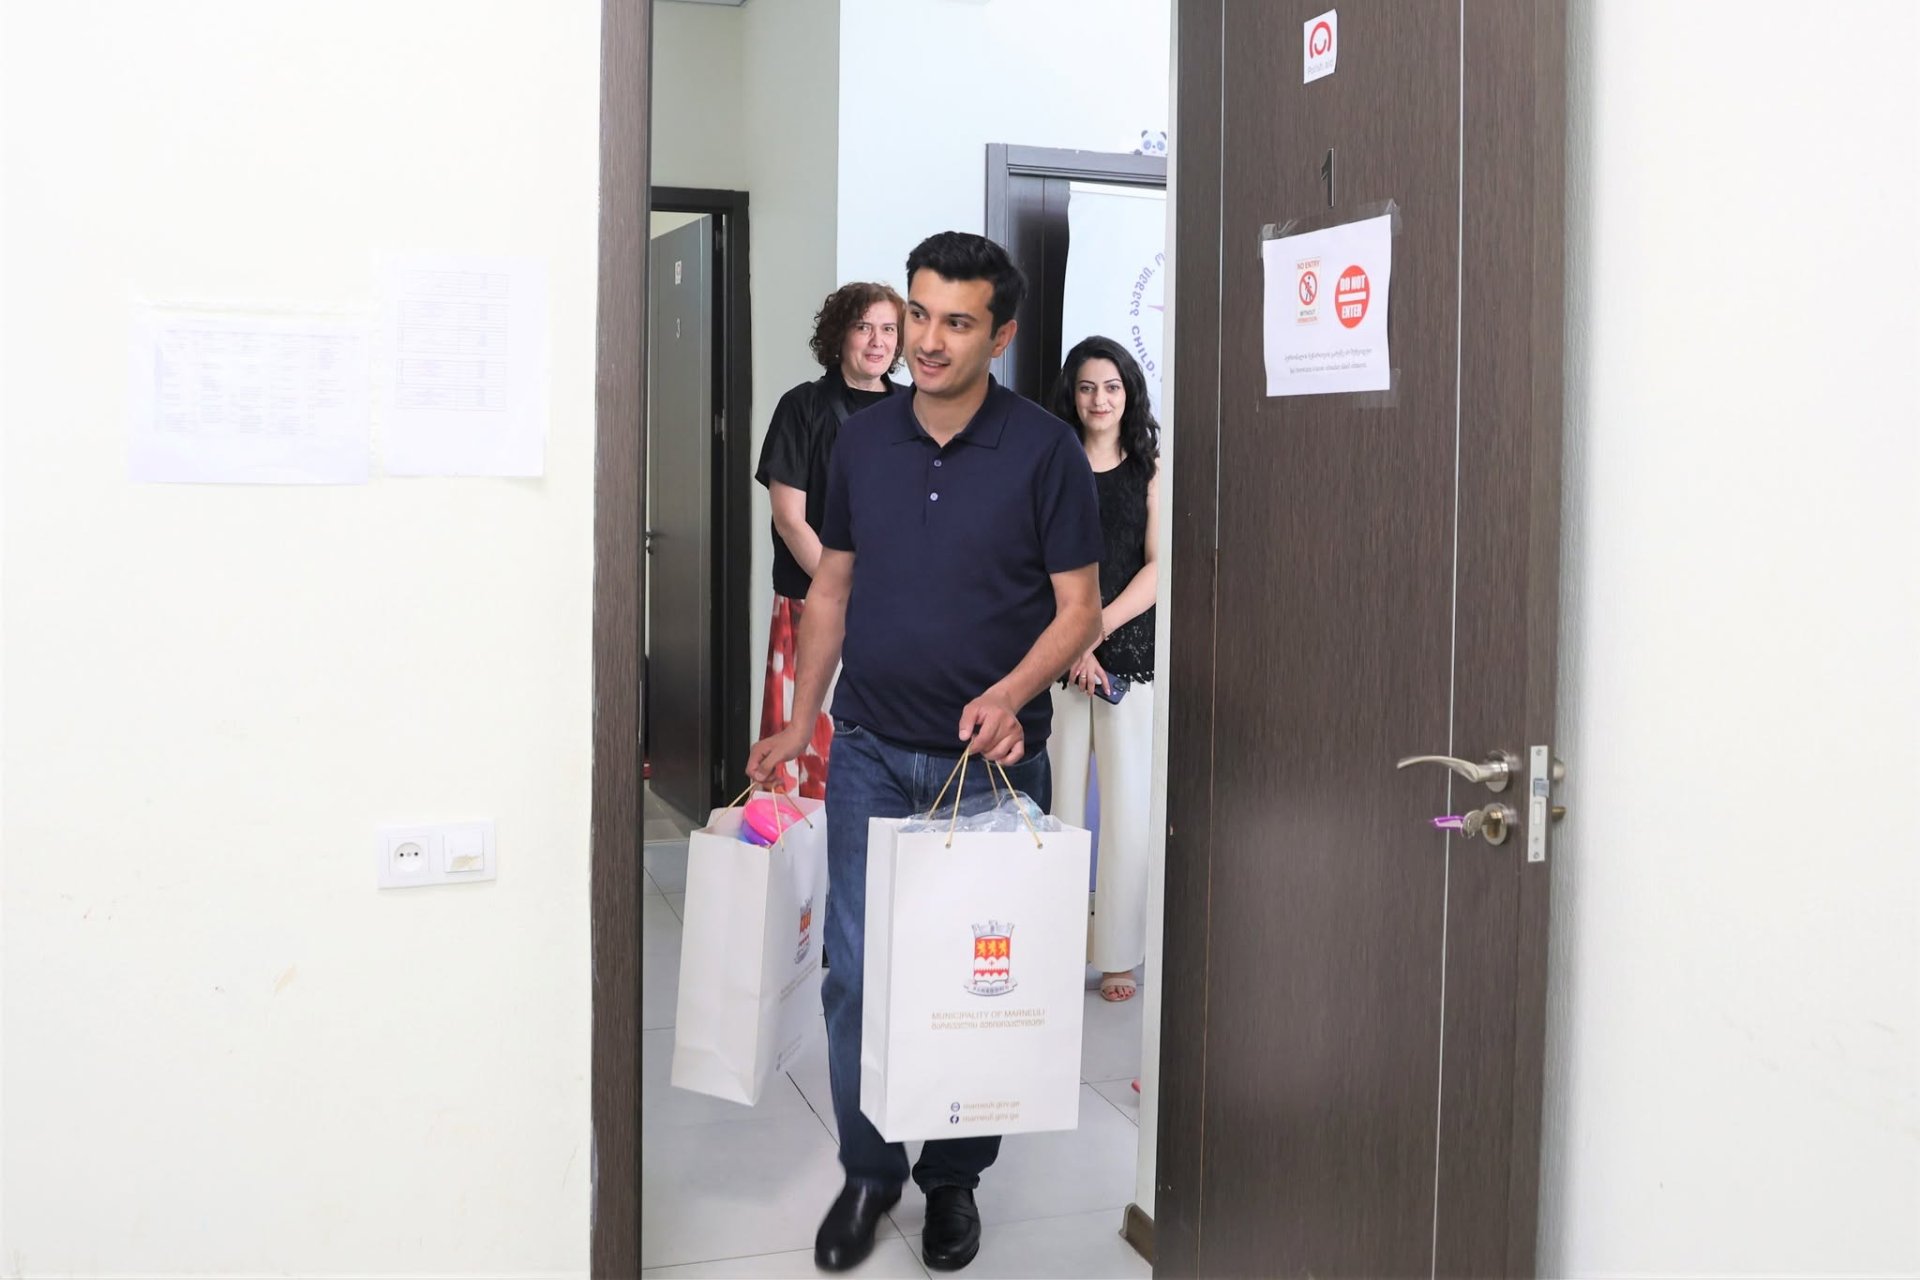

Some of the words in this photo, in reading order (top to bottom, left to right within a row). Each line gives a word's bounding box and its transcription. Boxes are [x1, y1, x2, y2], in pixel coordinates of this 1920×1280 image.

[1321, 148, 1335, 208] 1
[1340, 277, 1350, 291] DO
[1351, 275, 1366, 290] NOT
[1342, 304, 1362, 319] ENTER
[932, 1010, 988, 1020] MUNICIPALITY
[991, 1010, 1002, 1018] OF
[1004, 1008, 1045, 1017] MARNEULI
